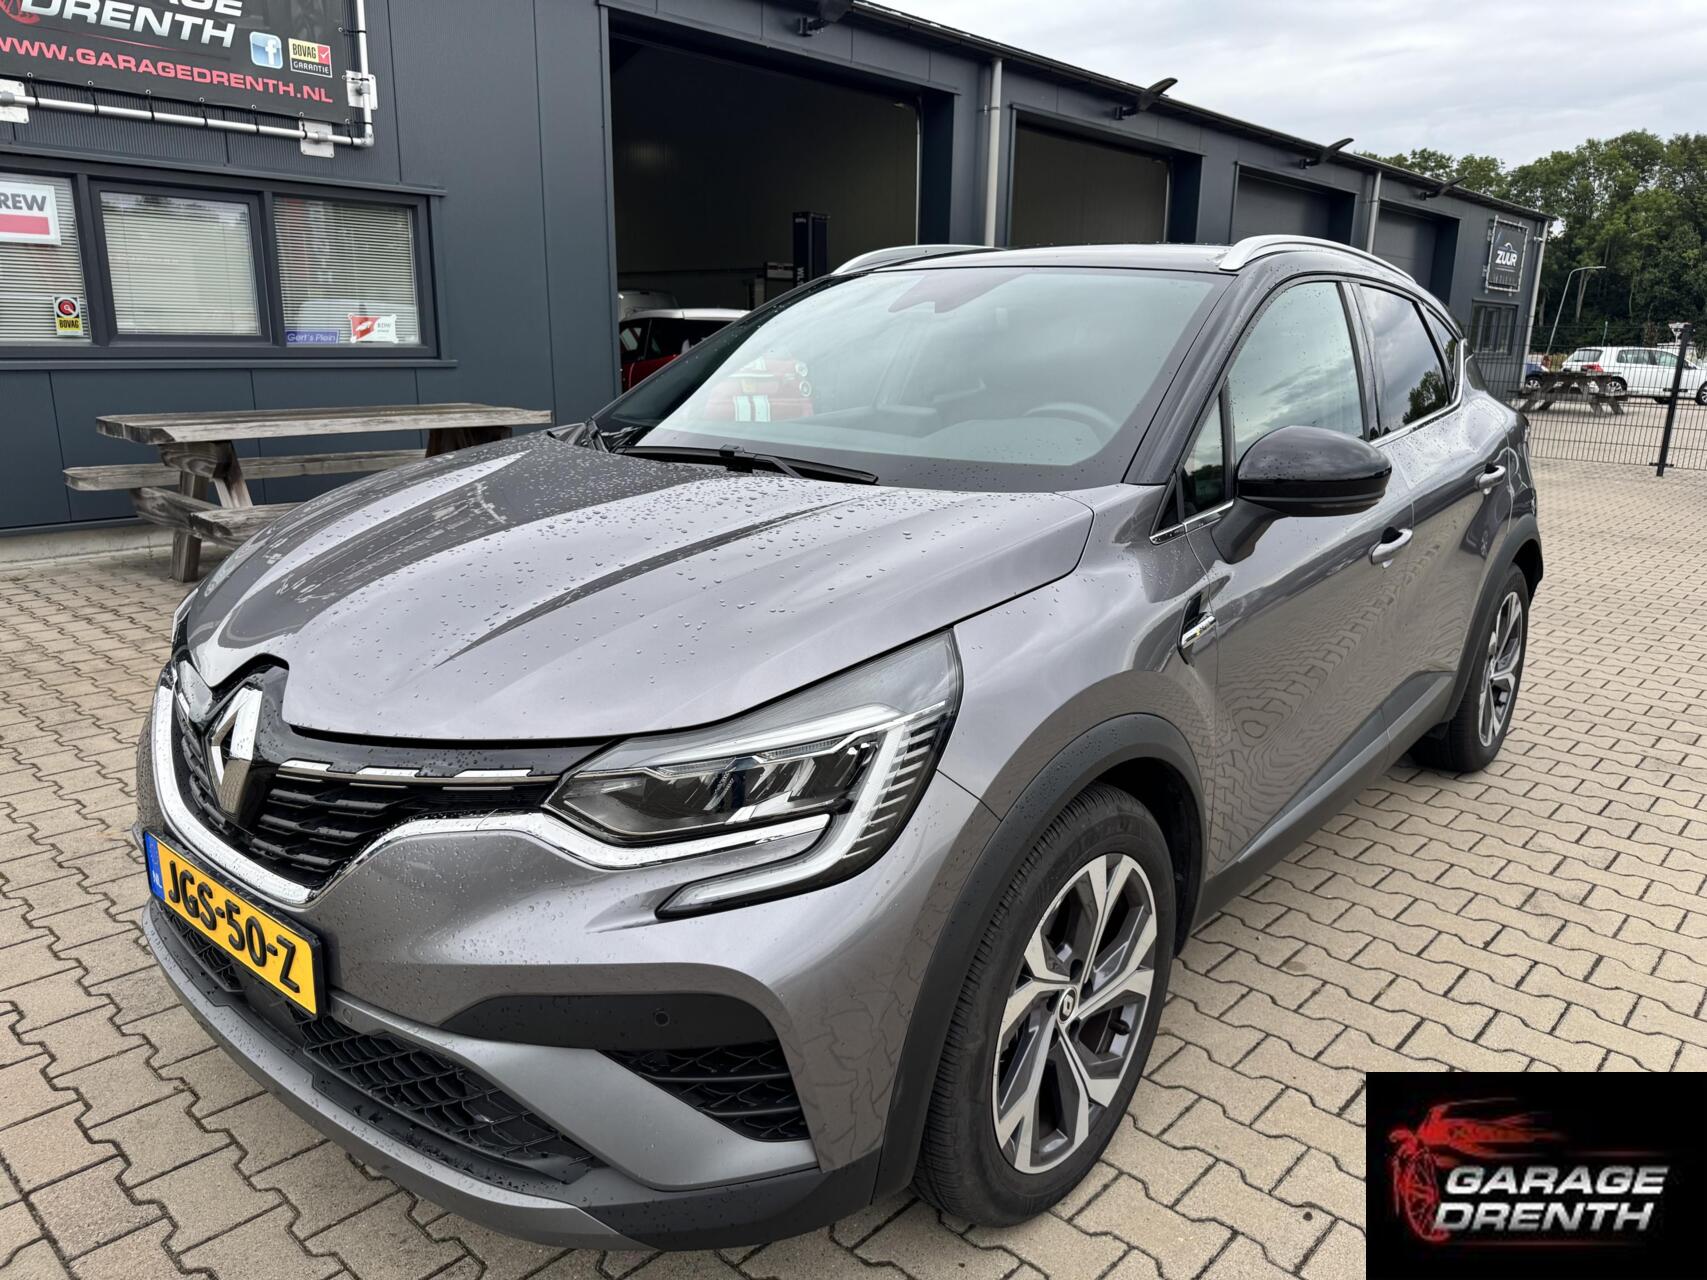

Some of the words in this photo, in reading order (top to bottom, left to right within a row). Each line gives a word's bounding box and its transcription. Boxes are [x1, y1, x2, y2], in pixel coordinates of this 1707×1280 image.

[20, 0, 235, 48] DRENTH
[292, 43, 317, 59] BOVAG
[293, 61, 329, 74] GARANTIE
[59, 319, 79, 328] BOVAG
[168, 860, 300, 993] JGS-50-Z
